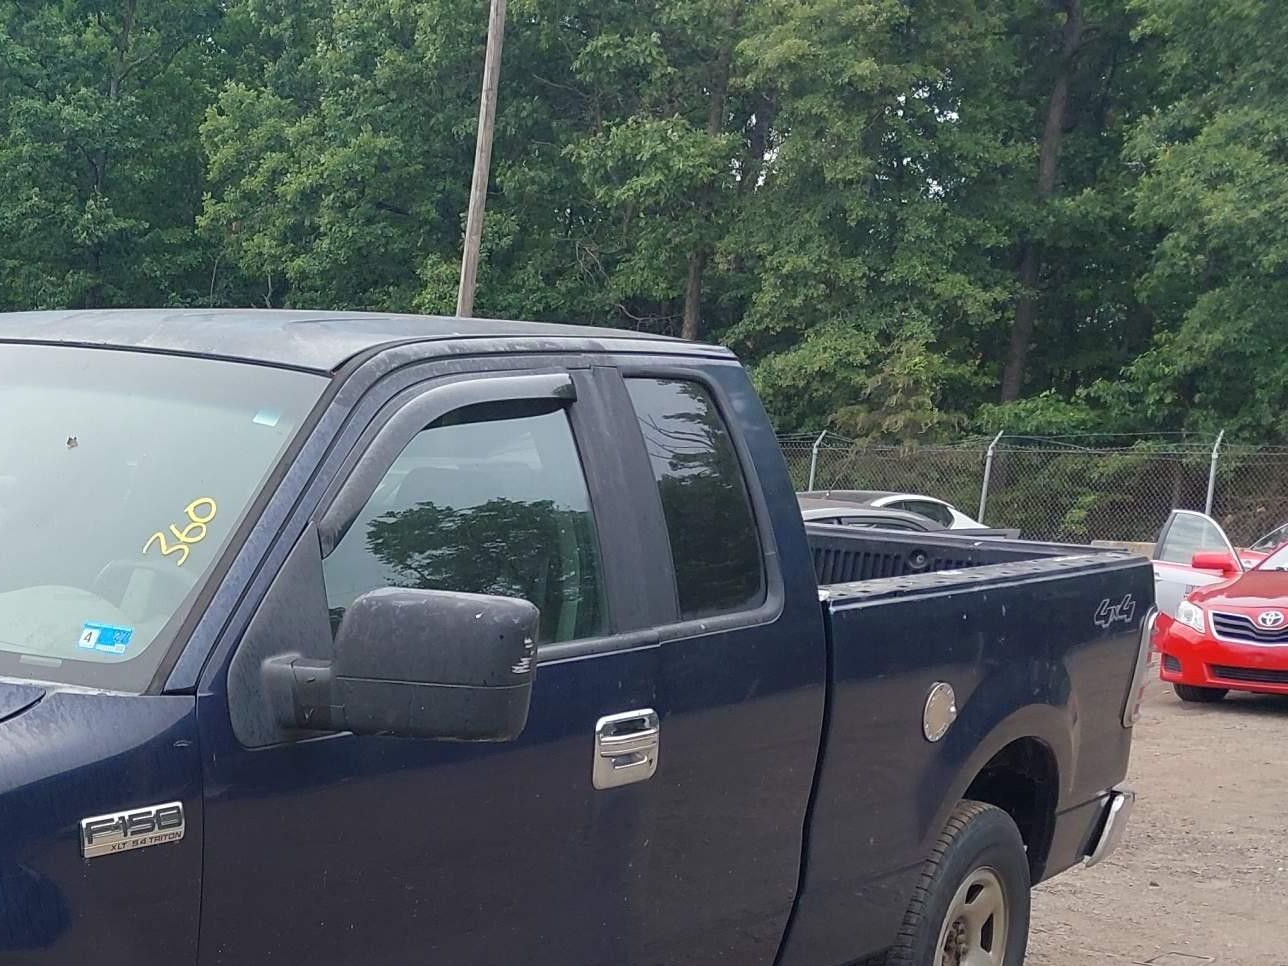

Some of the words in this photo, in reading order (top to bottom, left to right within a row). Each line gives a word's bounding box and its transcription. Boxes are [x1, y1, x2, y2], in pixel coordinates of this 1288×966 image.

[142, 496, 217, 567] 360
[1094, 593, 1136, 628] 4x4
[83, 631, 93, 643] 4
[110, 842, 128, 852] XLT
[148, 831, 182, 845] TRITON
